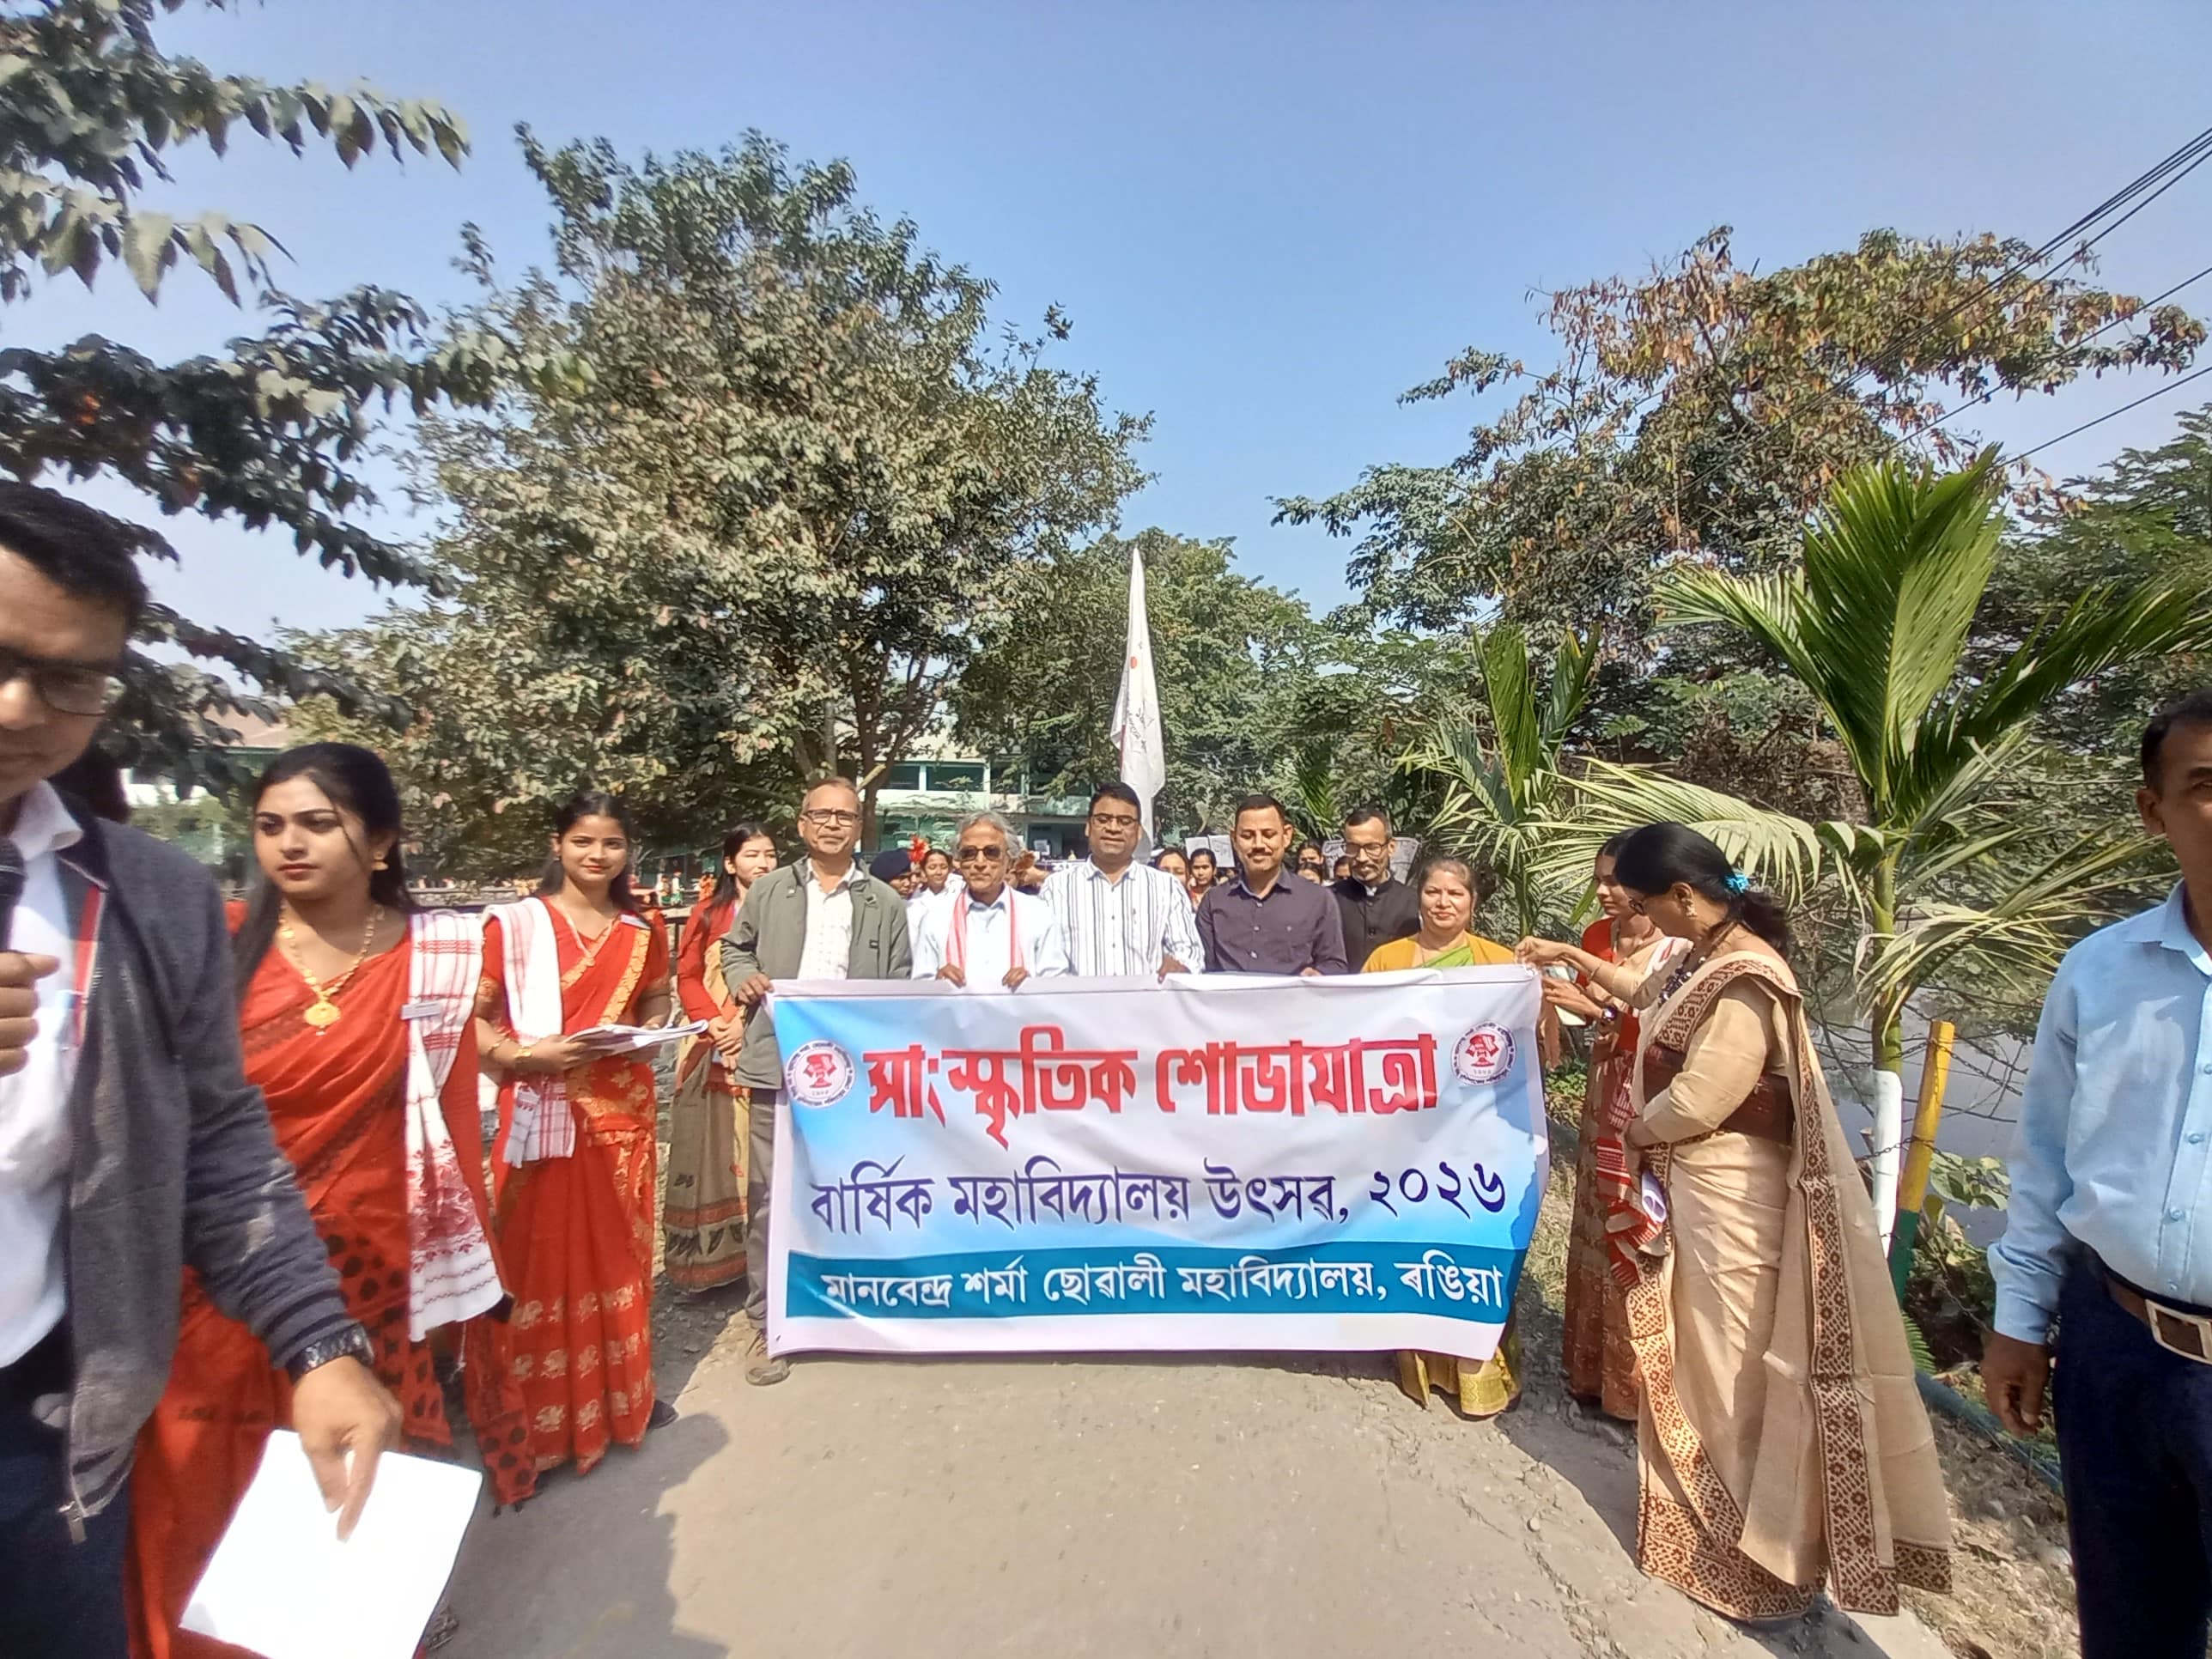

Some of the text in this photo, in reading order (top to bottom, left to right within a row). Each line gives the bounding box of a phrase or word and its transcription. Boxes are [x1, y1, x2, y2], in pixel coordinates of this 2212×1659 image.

[862, 1025, 1139, 1150] সাংস্কৃতিক
[947, 1155, 1190, 1231] মহাবিদ্যালয়
[1202, 1158, 1349, 1224] উৎসৱ,
[1369, 1161, 1506, 1219] ২০২৬
[1043, 1252, 1168, 1306] ছোৱালী
[1393, 1249, 1504, 1310] ৰঙিয়া
